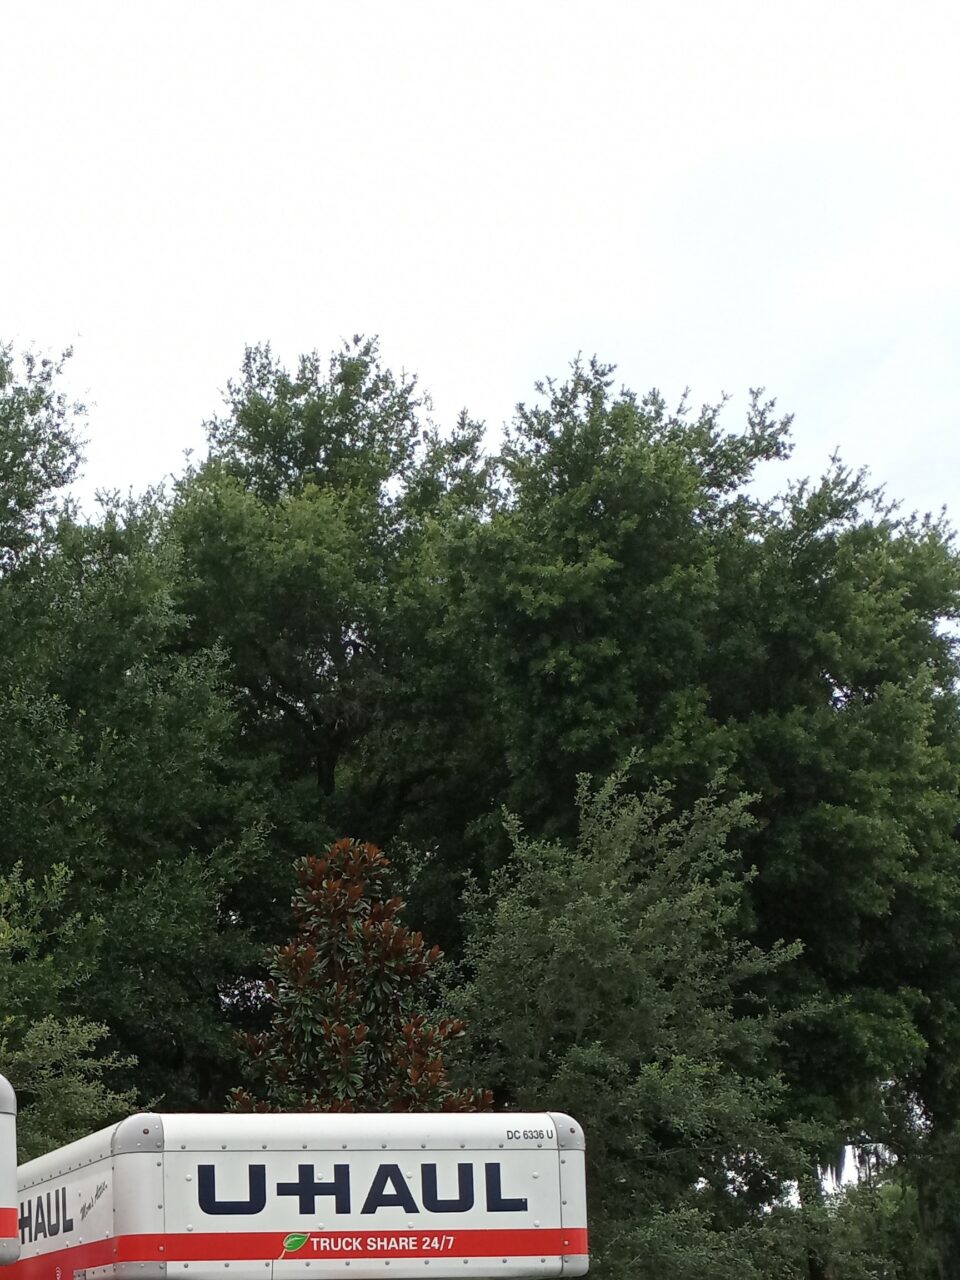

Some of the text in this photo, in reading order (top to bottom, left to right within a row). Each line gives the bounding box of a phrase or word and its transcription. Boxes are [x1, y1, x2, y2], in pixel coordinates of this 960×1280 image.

[506, 1129, 554, 1140] DC 6336 U
[197, 1162, 529, 1216] U-HAUL
[310, 1235, 454, 1252] TRUCK SHARE 24/7
